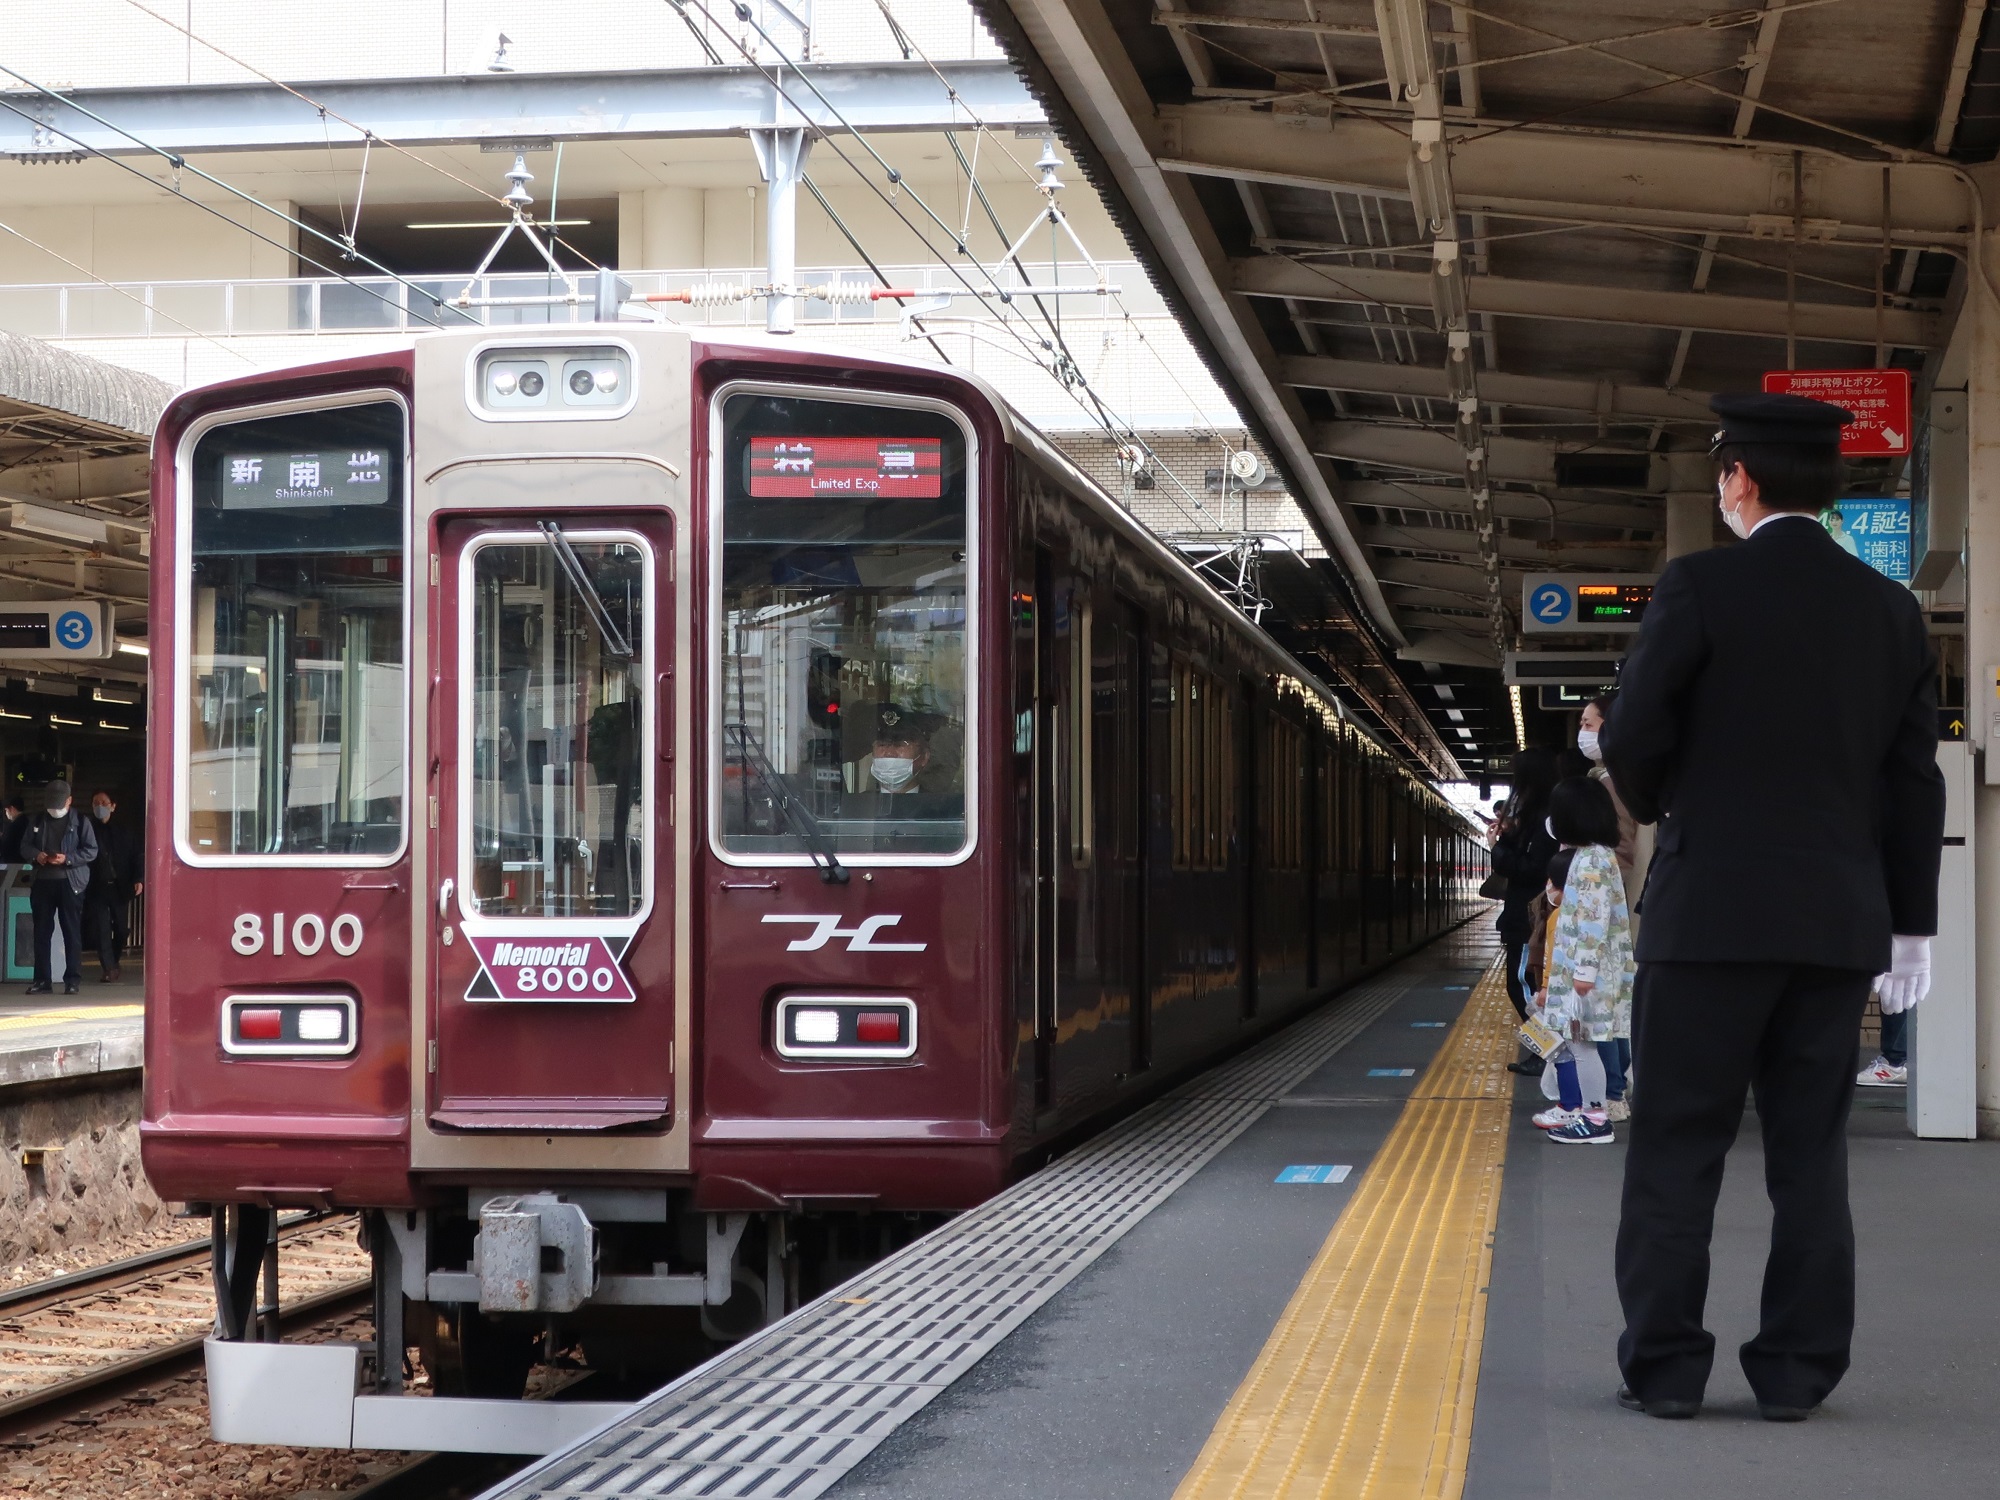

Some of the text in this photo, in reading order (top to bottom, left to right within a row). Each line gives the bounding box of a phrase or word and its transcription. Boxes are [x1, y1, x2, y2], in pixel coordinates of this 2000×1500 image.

[1790, 377, 1883, 388] 列車非常停止ボタン
[1846, 388, 1862, 396] Stop
[275, 487, 334, 499] Shinkaichi
[810, 478, 881, 491] Limited Exp.
[1871, 540, 1908, 558] 歯科
[1540, 591, 1562, 616] 2
[64, 619, 85, 642] 3
[231, 913, 364, 956] 8100
[492, 942, 592, 967] Memorial
[516, 967, 614, 992] 8000
[1874, 1069, 1891, 1080] N
